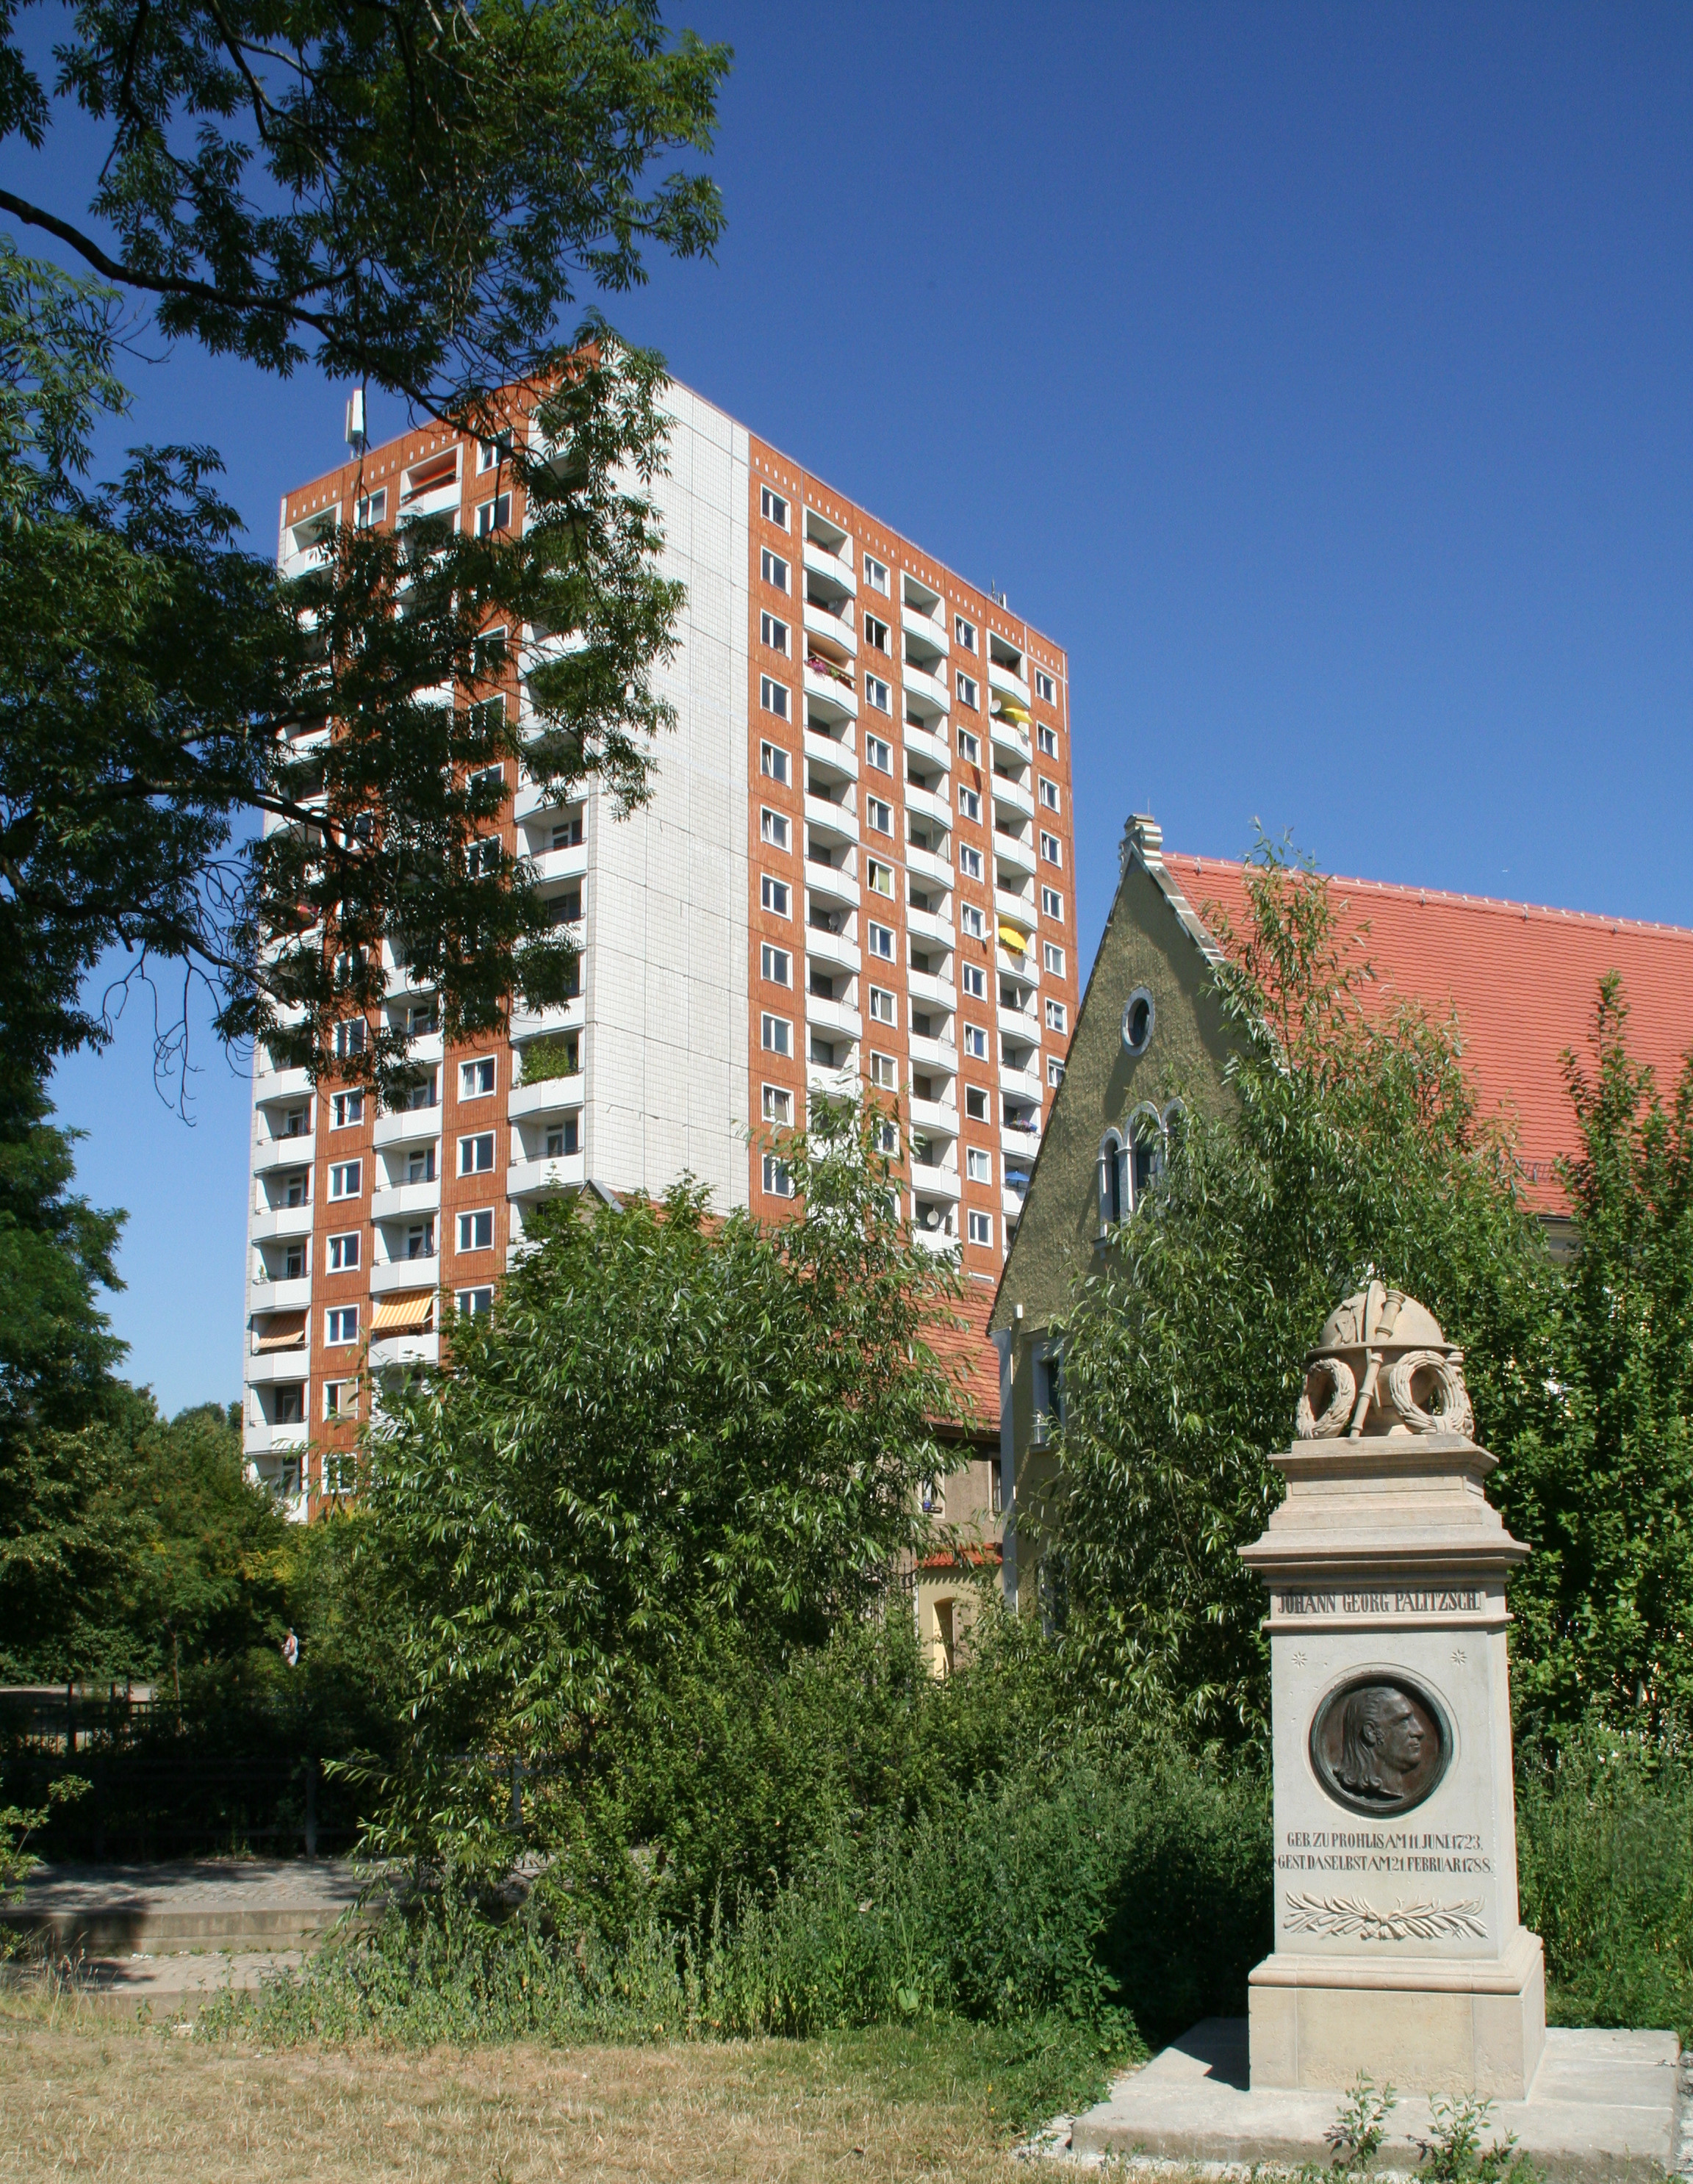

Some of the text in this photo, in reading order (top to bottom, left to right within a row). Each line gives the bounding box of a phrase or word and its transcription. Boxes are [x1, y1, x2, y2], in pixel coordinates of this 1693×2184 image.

[1278, 1592, 1336, 1613] JOHANN
[1343, 1590, 1390, 1612] GEORG
[1313, 1832, 1330, 1848] ZU
[1331, 1833, 1384, 1849] PROHLIS
[1385, 1834, 1406, 1849] AM
[1307, 1855, 1367, 1870] DASELBST
[1367, 1856, 1390, 1871] AM
[1407, 1856, 1461, 1873] FEBRUAR
[1462, 1857, 1493, 1873] 1788.
